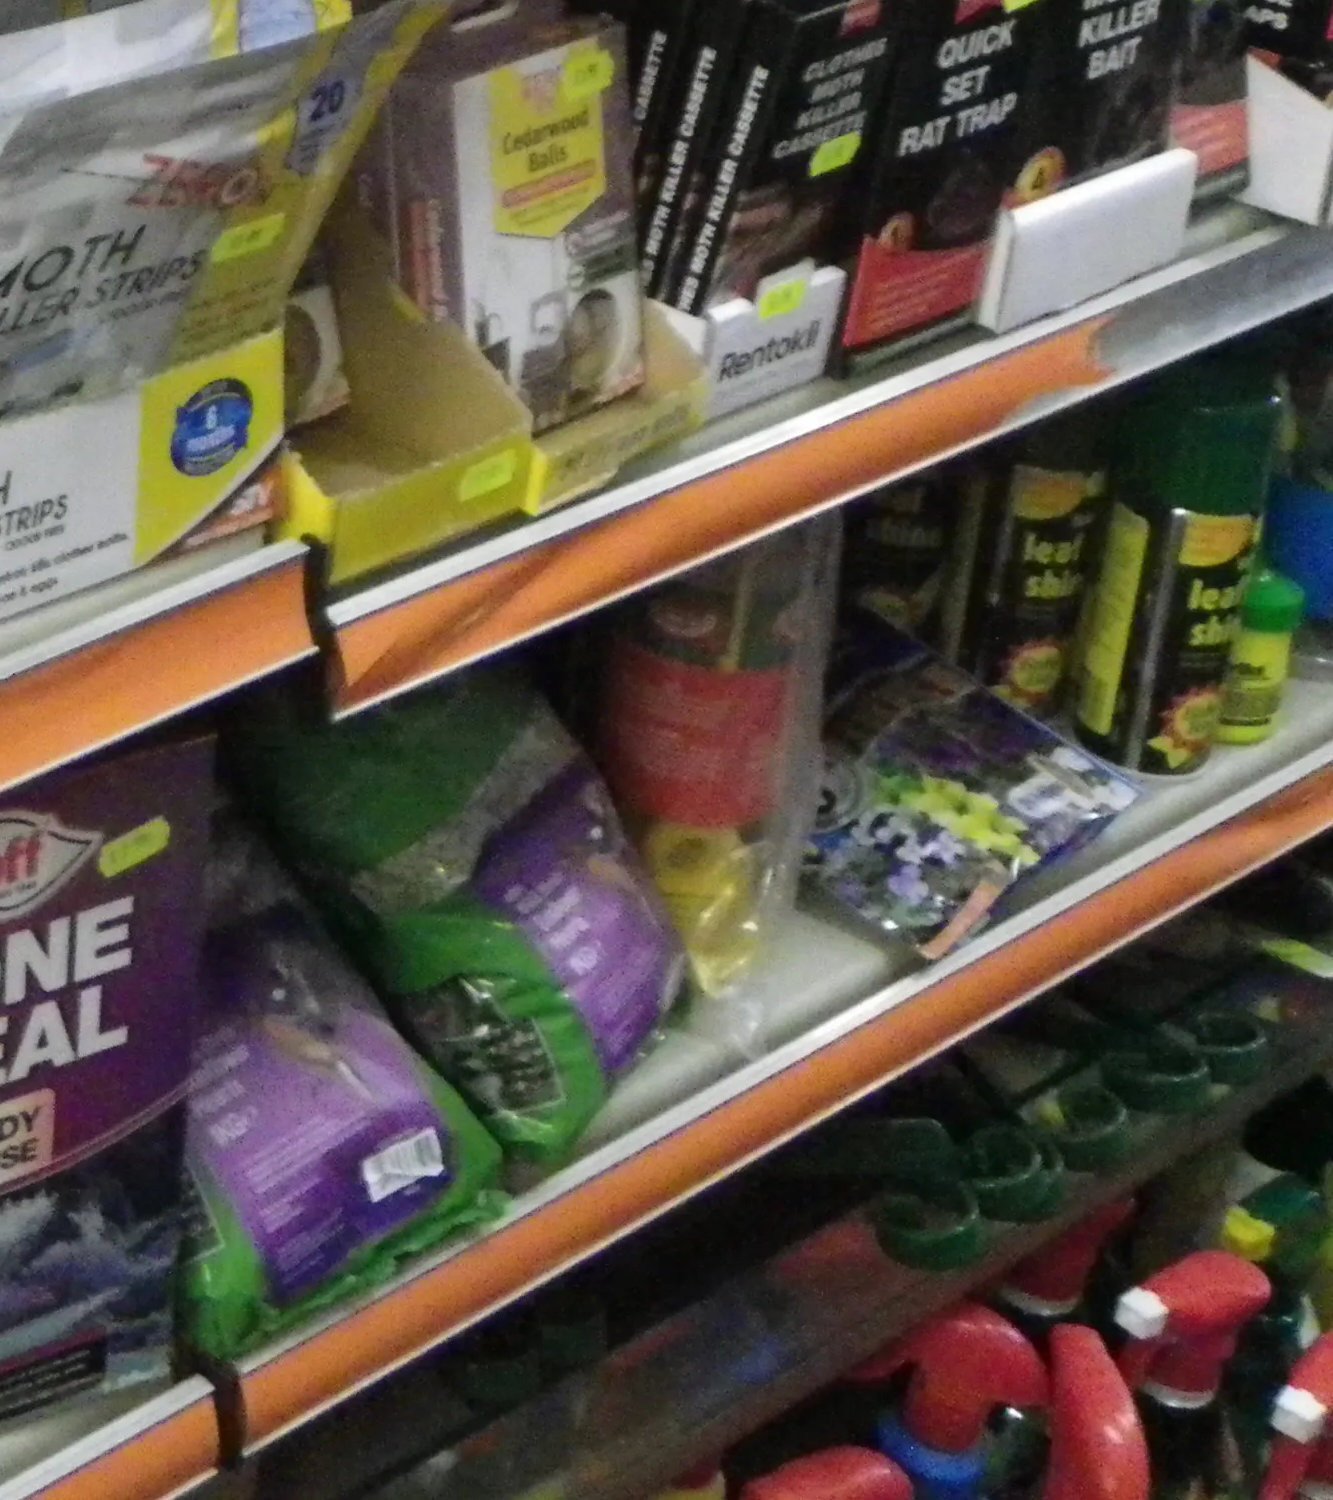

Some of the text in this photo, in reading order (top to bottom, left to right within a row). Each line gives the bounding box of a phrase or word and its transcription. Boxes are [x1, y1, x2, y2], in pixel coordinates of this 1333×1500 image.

[936, 19, 1018, 70] QUICK
[1086, 36, 1144, 82] BAIT
[940, 64, 993, 107] SET
[896, 91, 1018, 158] RAT TRAP
[526, 144, 569, 174] Balls
[718, 318, 821, 384] Rentokil
